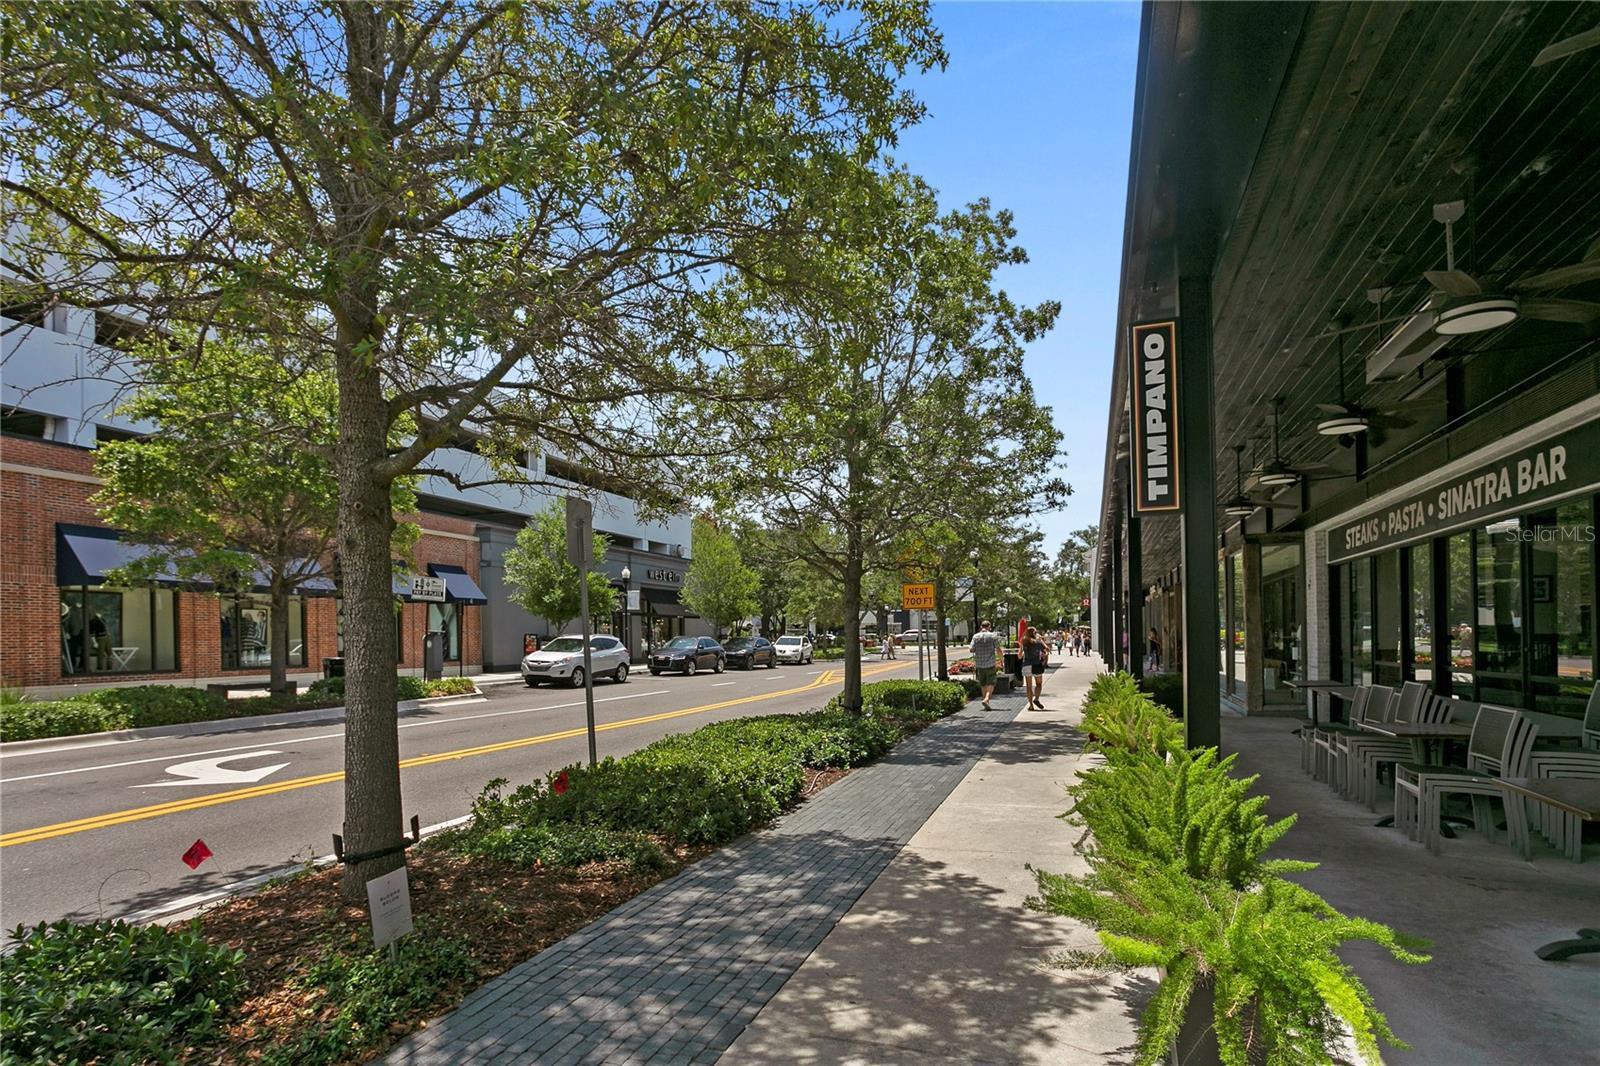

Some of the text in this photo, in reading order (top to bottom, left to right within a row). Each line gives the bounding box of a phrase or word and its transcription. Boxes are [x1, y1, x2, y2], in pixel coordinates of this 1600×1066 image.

[1143, 333, 1168, 500] TIMPANO
[1345, 445, 1566, 549] STEAKS PASTA SINATRA BAR
[647, 569, 667, 582] west
[908, 587, 928, 596] NEXT
[905, 597, 933, 605] 700 FT
